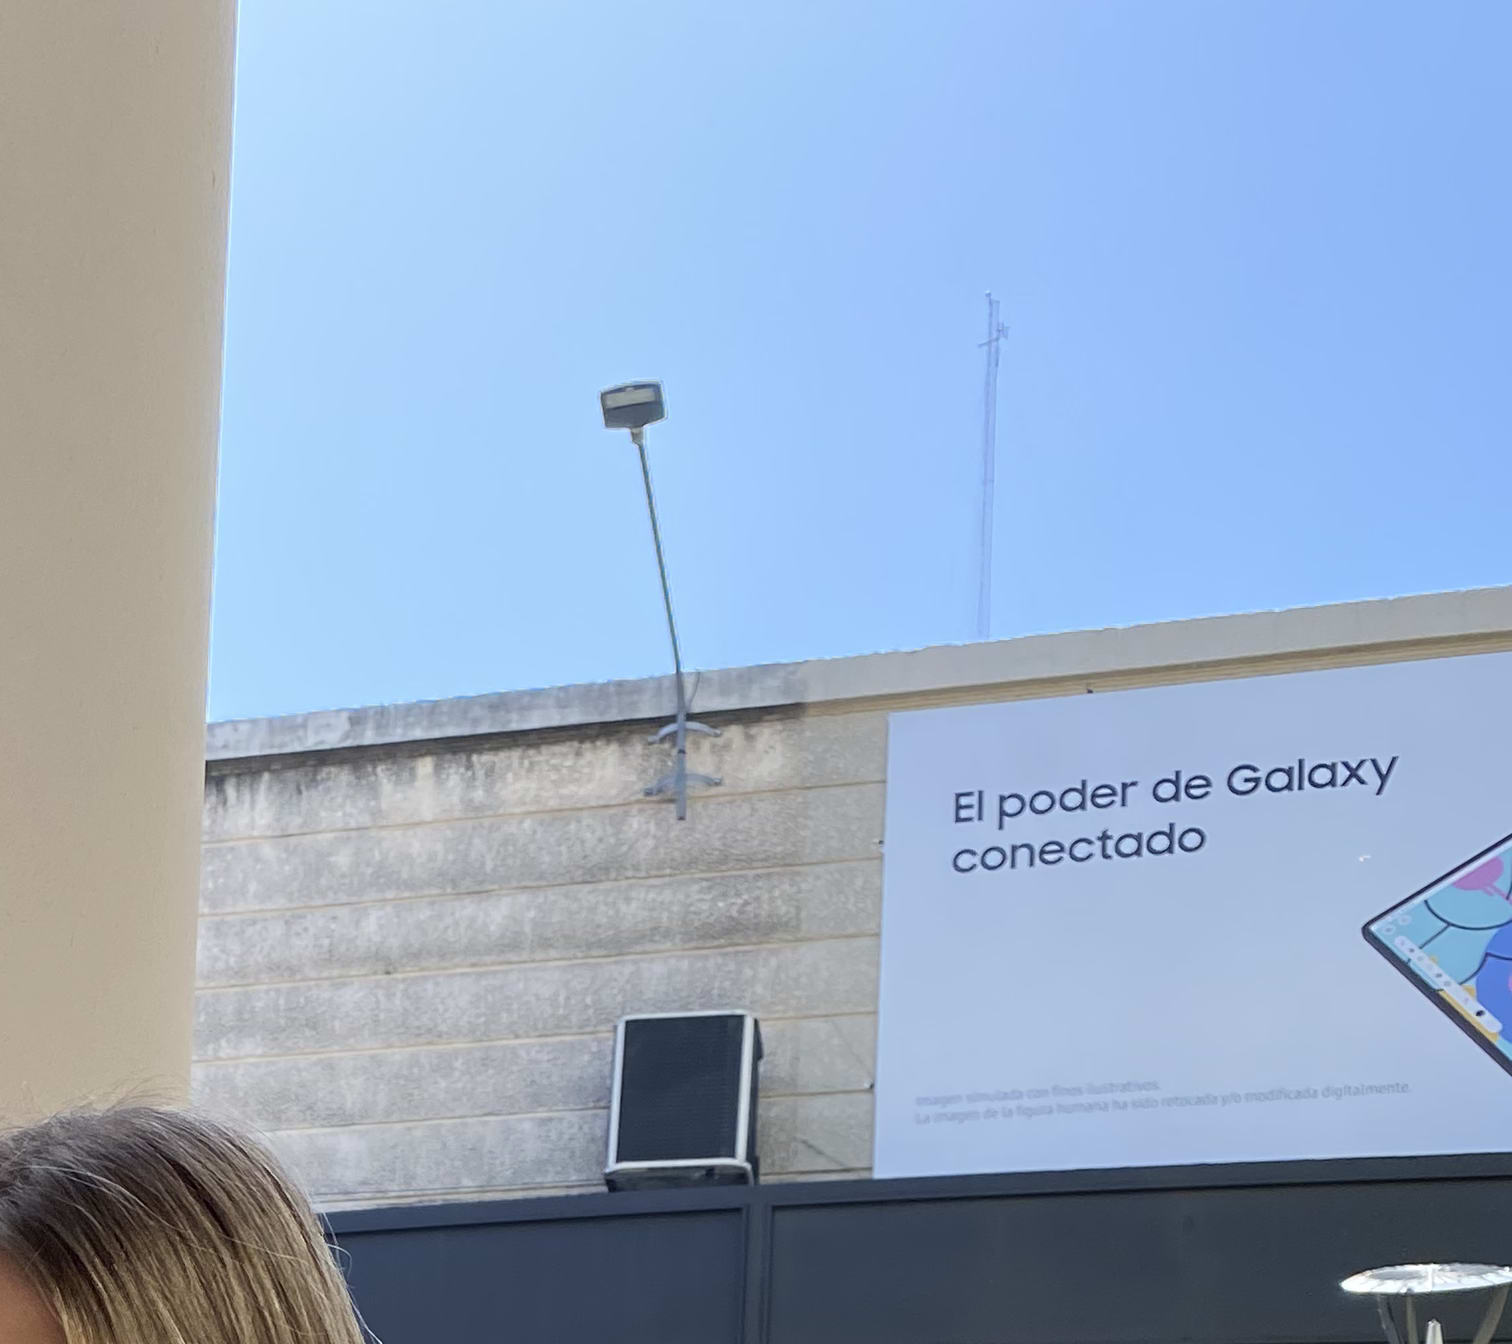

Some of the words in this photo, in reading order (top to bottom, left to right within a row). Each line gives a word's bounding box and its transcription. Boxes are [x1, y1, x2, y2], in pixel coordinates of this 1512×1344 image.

[954, 789, 984, 824] El
[997, 779, 1139, 831] poder
[1151, 769, 1213, 804] de
[1226, 755, 1399, 797] Galaxy
[952, 822, 1207, 874] conectado
